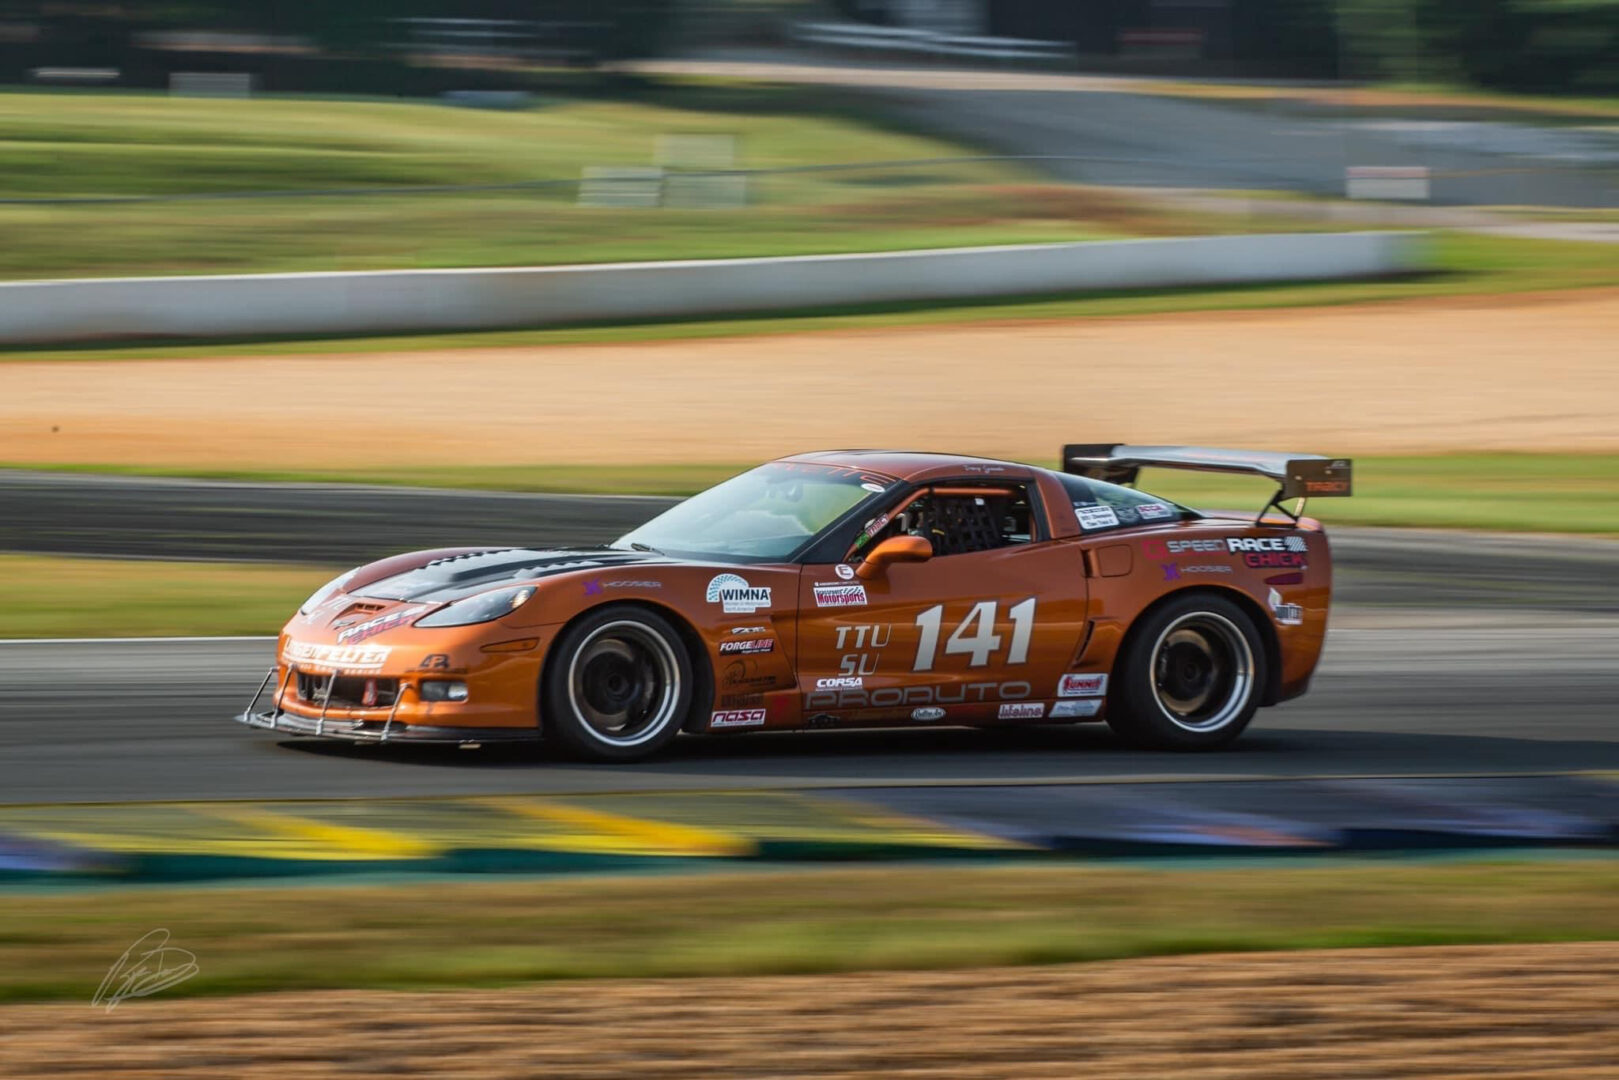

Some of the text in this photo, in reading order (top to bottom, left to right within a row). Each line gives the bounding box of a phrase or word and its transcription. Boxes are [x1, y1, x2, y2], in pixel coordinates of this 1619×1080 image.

[1166, 539, 1227, 553] SPEED
[1226, 538, 1286, 552] RACE
[1245, 553, 1306, 567] CHICK
[838, 565, 851, 576] E
[722, 588, 769, 601] WIMNA
[817, 592, 865, 605] Motorsports
[337, 612, 403, 645] RACE
[912, 597, 1037, 672] 141
[835, 624, 892, 650] TTU
[838, 653, 880, 677] SU
[816, 677, 863, 688] CORSA
[712, 711, 765, 722] nasa
